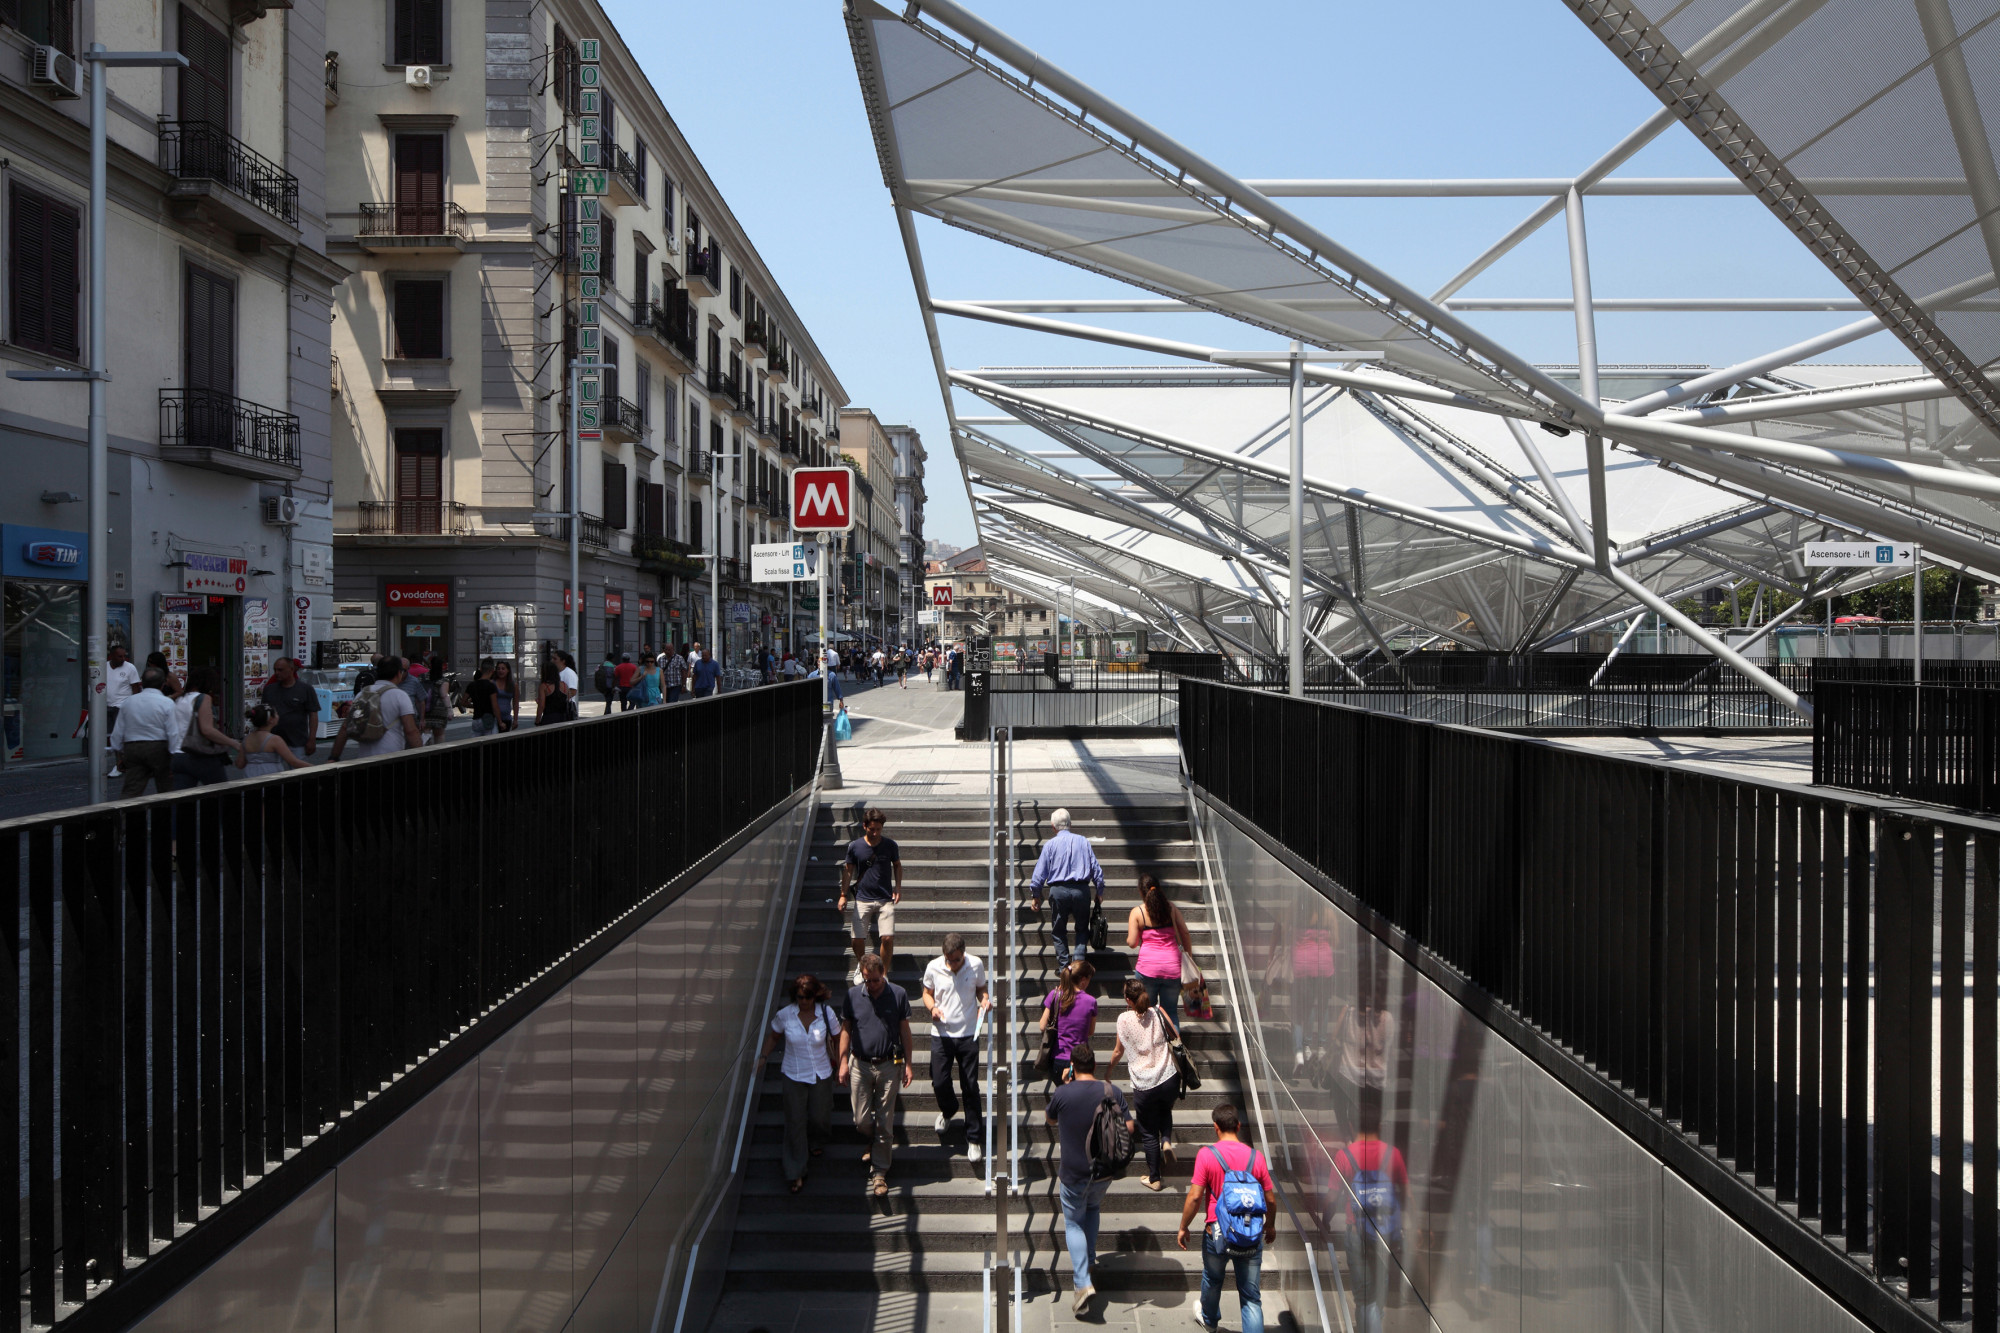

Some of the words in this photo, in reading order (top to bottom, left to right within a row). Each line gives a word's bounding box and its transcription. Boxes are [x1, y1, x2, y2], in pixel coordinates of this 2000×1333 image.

[581, 41, 598, 163] HOTEL
[574, 177, 606, 194] HV
[581, 200, 598, 426] VERGILIUS
[799, 482, 845, 517] M
[56, 547, 78, 563] TIM
[1810, 550, 1851, 558] Ascensore
[1858, 550, 1870, 558] Lift
[185, 553, 227, 573] CHICKEN
[229, 558, 248, 574] HUT
[778, 567, 790, 575] fissa
[402, 590, 445, 599] vodafone
[935, 590, 951, 602] M
[166, 598, 190, 608] CHICKEN
[733, 603, 750, 612] BAR
[298, 610, 307, 647] CHICKEN
